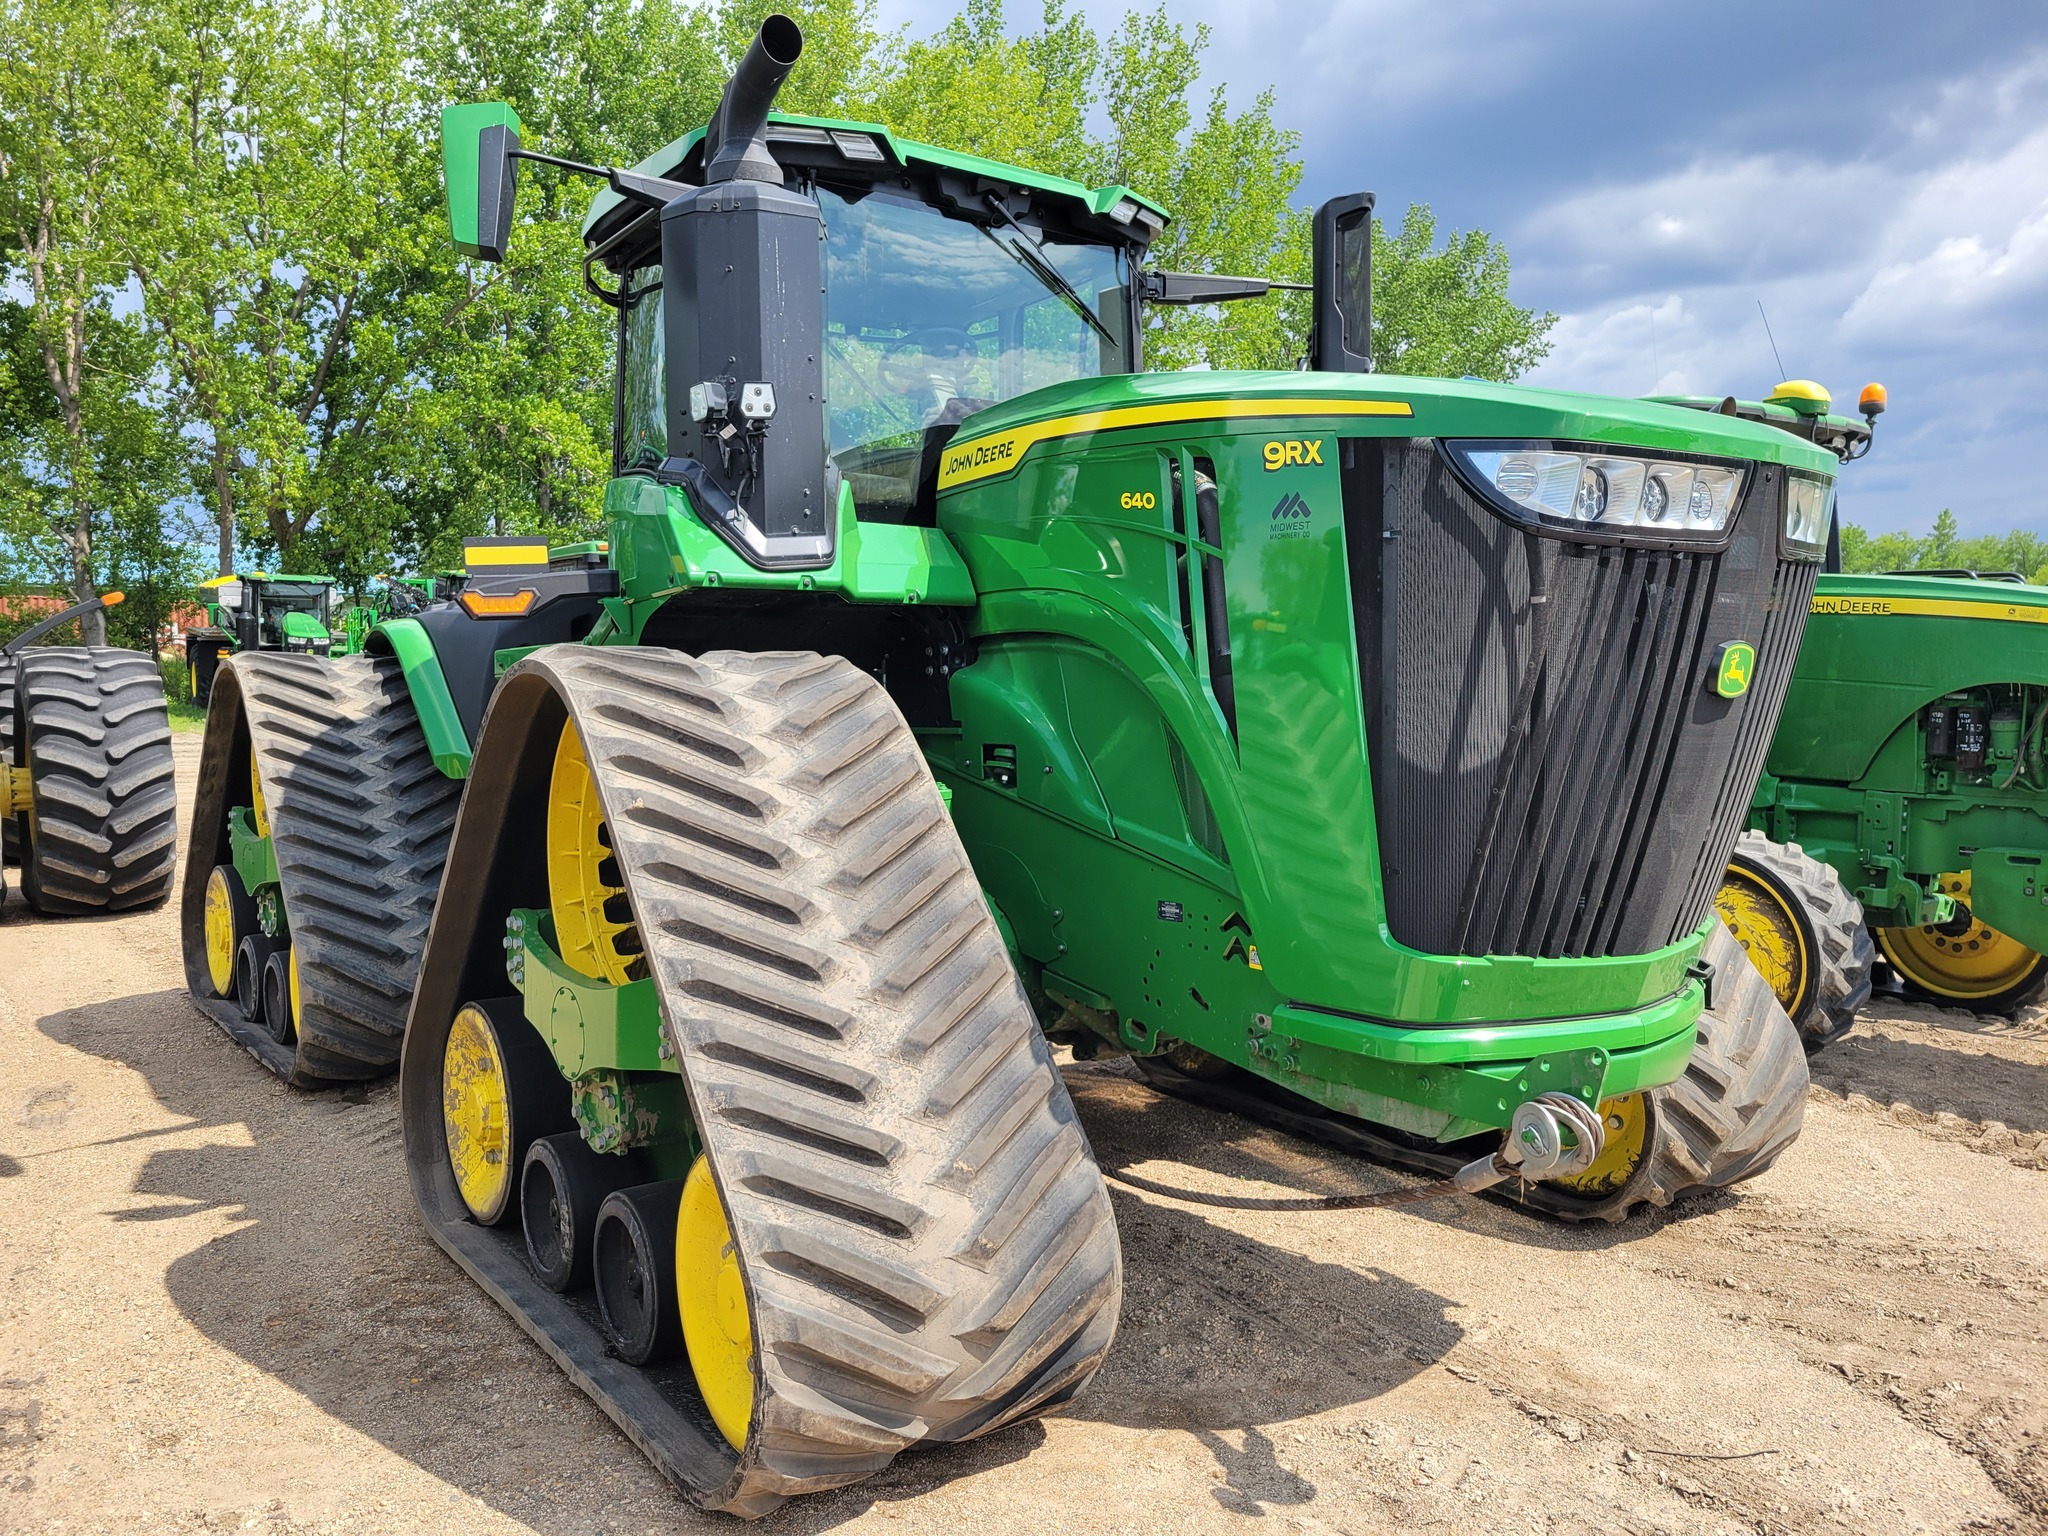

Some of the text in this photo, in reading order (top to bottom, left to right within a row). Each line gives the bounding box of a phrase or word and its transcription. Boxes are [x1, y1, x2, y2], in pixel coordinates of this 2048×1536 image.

[945, 440, 1015, 475] JOHN DEERE
[1262, 439, 1324, 471] 9RX
[1120, 491, 1156, 510] 640
[1270, 520, 1311, 532] MIDWEST
[1270, 531, 1301, 540] MACHINERY
[1840, 599, 1892, 613] DEERE
